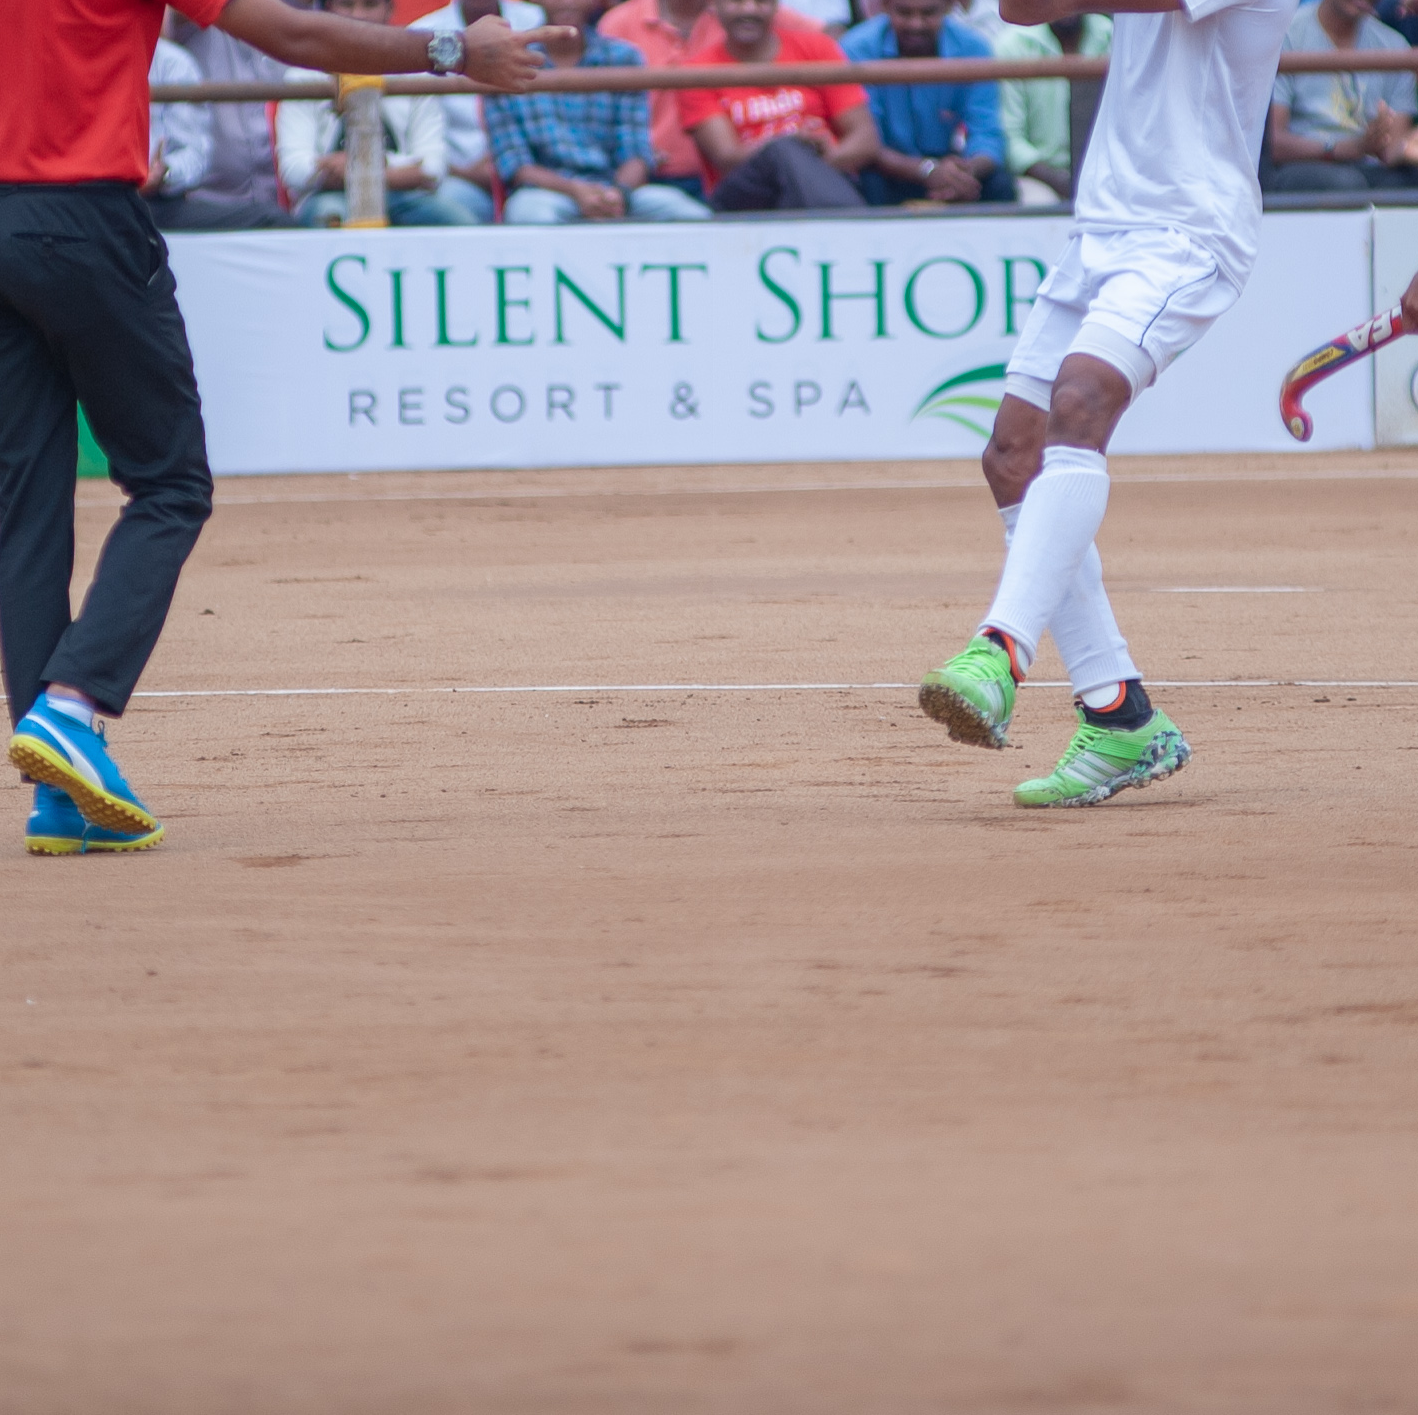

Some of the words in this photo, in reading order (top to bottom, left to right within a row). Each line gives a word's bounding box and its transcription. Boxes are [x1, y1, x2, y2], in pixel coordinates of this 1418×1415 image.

[322, 252, 708, 353] SILENT
[348, 382, 623, 427] RESORT
[668, 380, 701, 421] &
[747, 379, 872, 420] SPA
